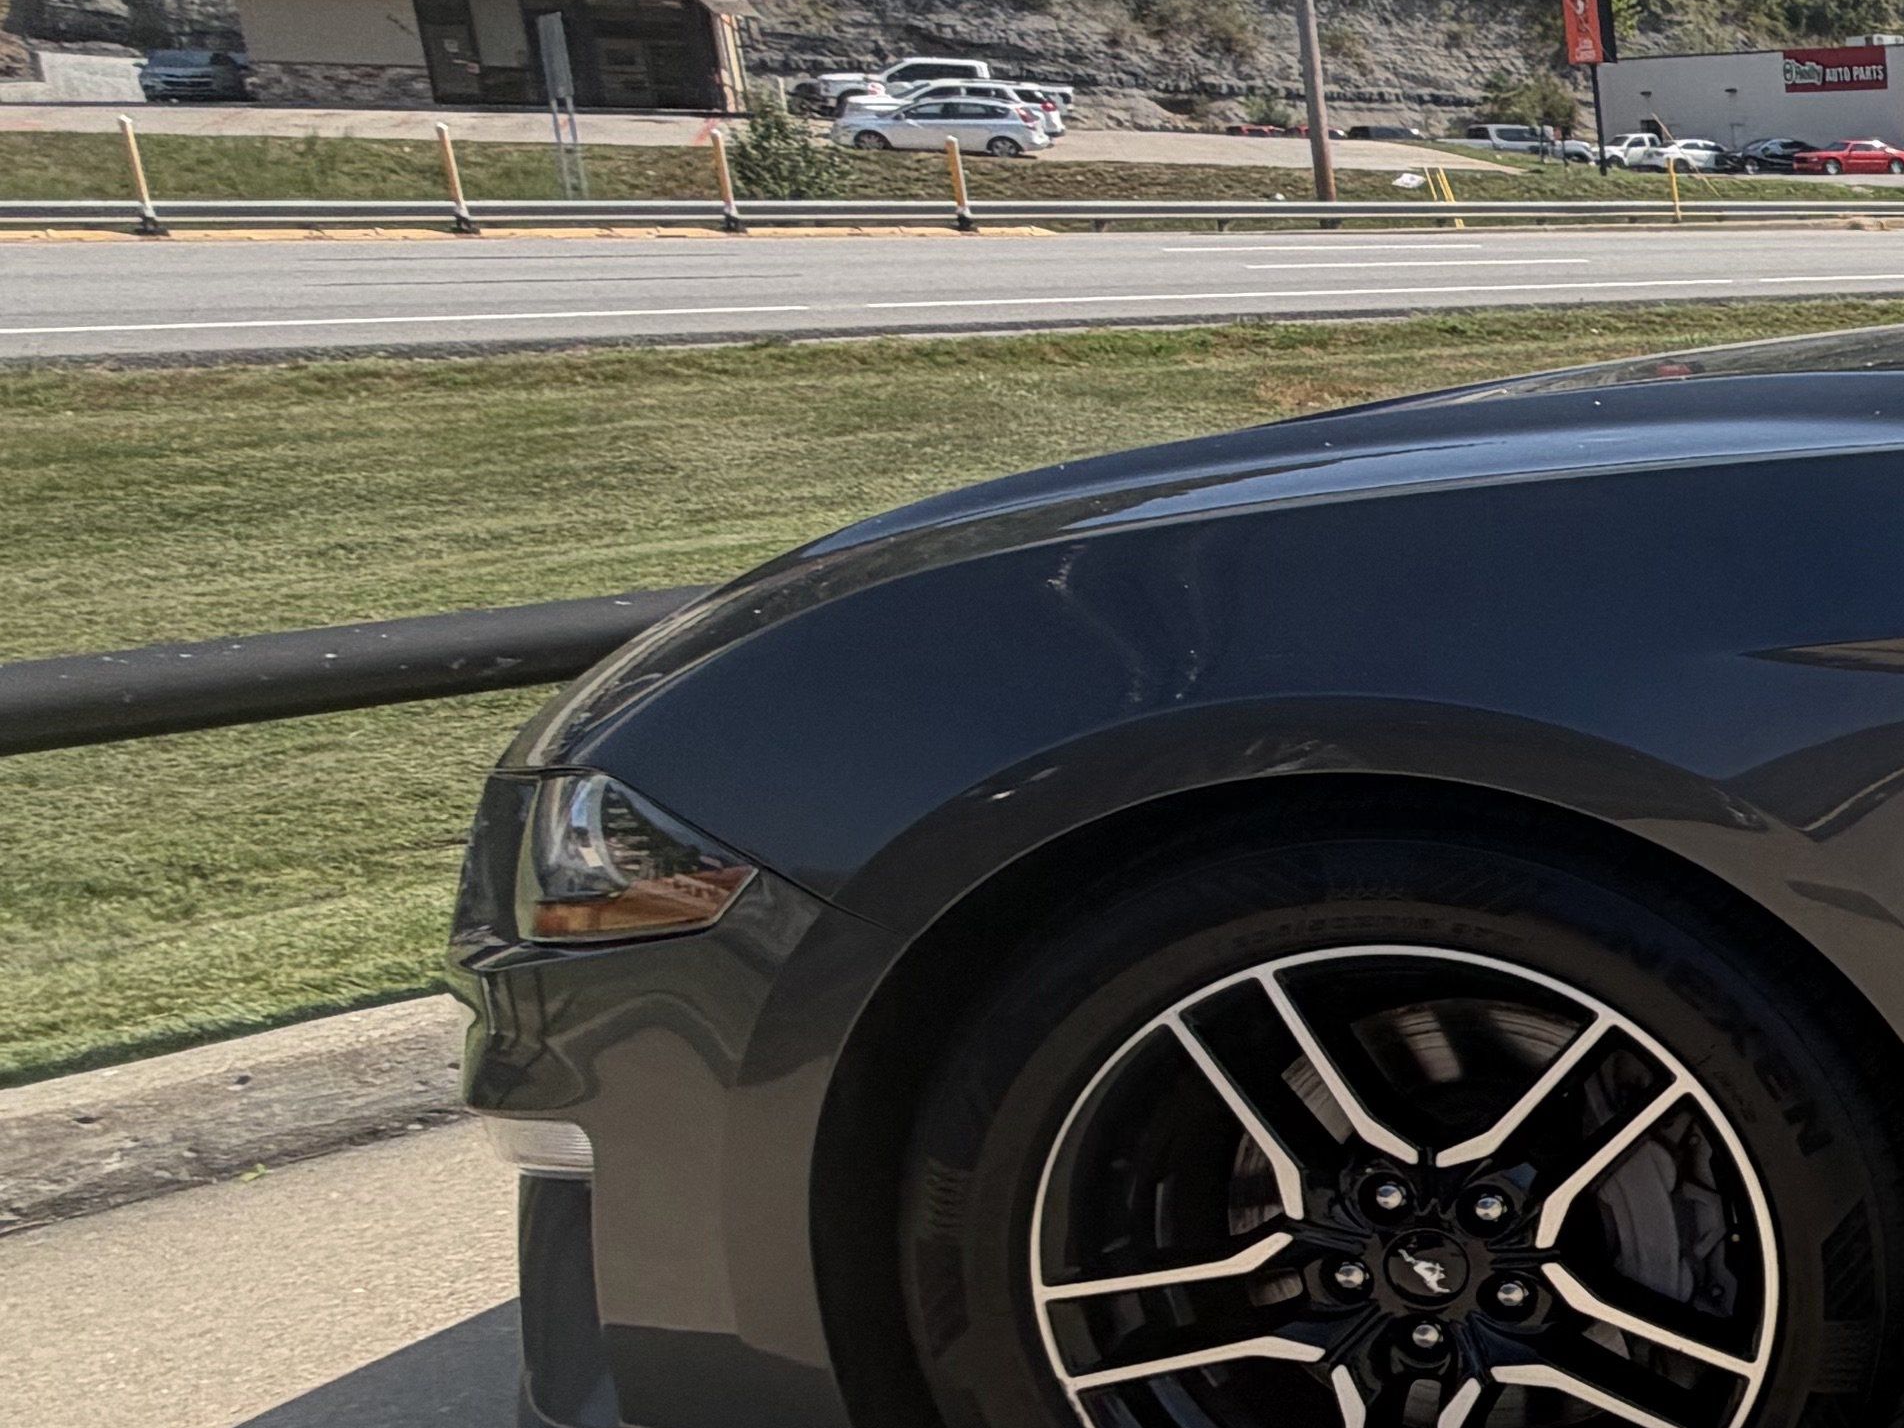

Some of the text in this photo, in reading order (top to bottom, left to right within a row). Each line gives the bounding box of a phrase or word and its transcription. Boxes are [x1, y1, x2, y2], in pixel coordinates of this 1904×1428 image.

[1826, 66, 1851, 83] AUTO
[1852, 65, 1885, 82] PARTS
[1608, 926, 1835, 1159] NEXEN
